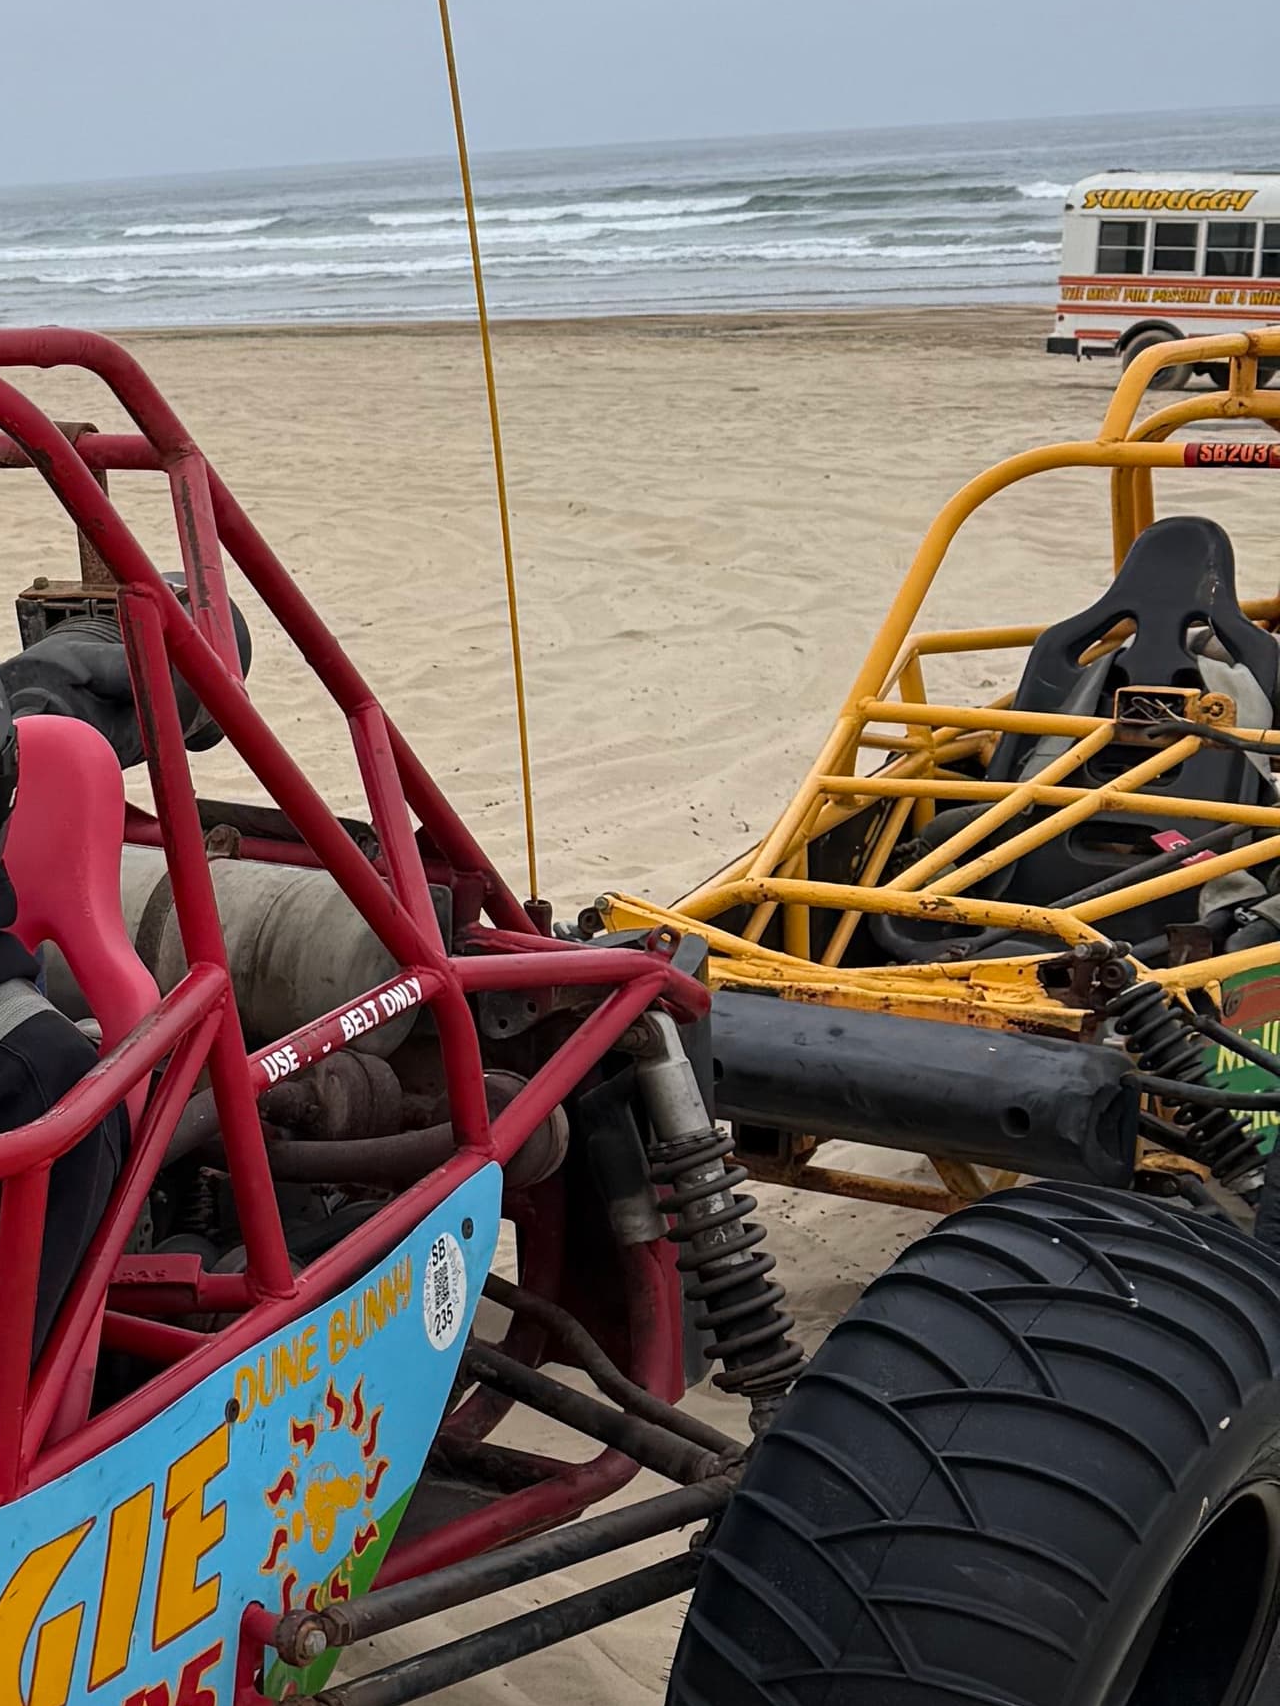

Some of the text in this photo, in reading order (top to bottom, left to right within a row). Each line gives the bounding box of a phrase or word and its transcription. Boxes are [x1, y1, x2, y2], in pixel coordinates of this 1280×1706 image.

[1081, 188, 1259, 211] SUNBUGGY
[1200, 443, 1268, 463] SB203
[260, 1045, 300, 1083] USE
[340, 999, 380, 1042] BELT
[379, 976, 423, 1017] ONLY
[431, 1237, 446, 1267] SB
[435, 1302, 454, 1337] 235
[233, 1324, 320, 1424] DUNE
[328, 1253, 412, 1366] BUNNY
